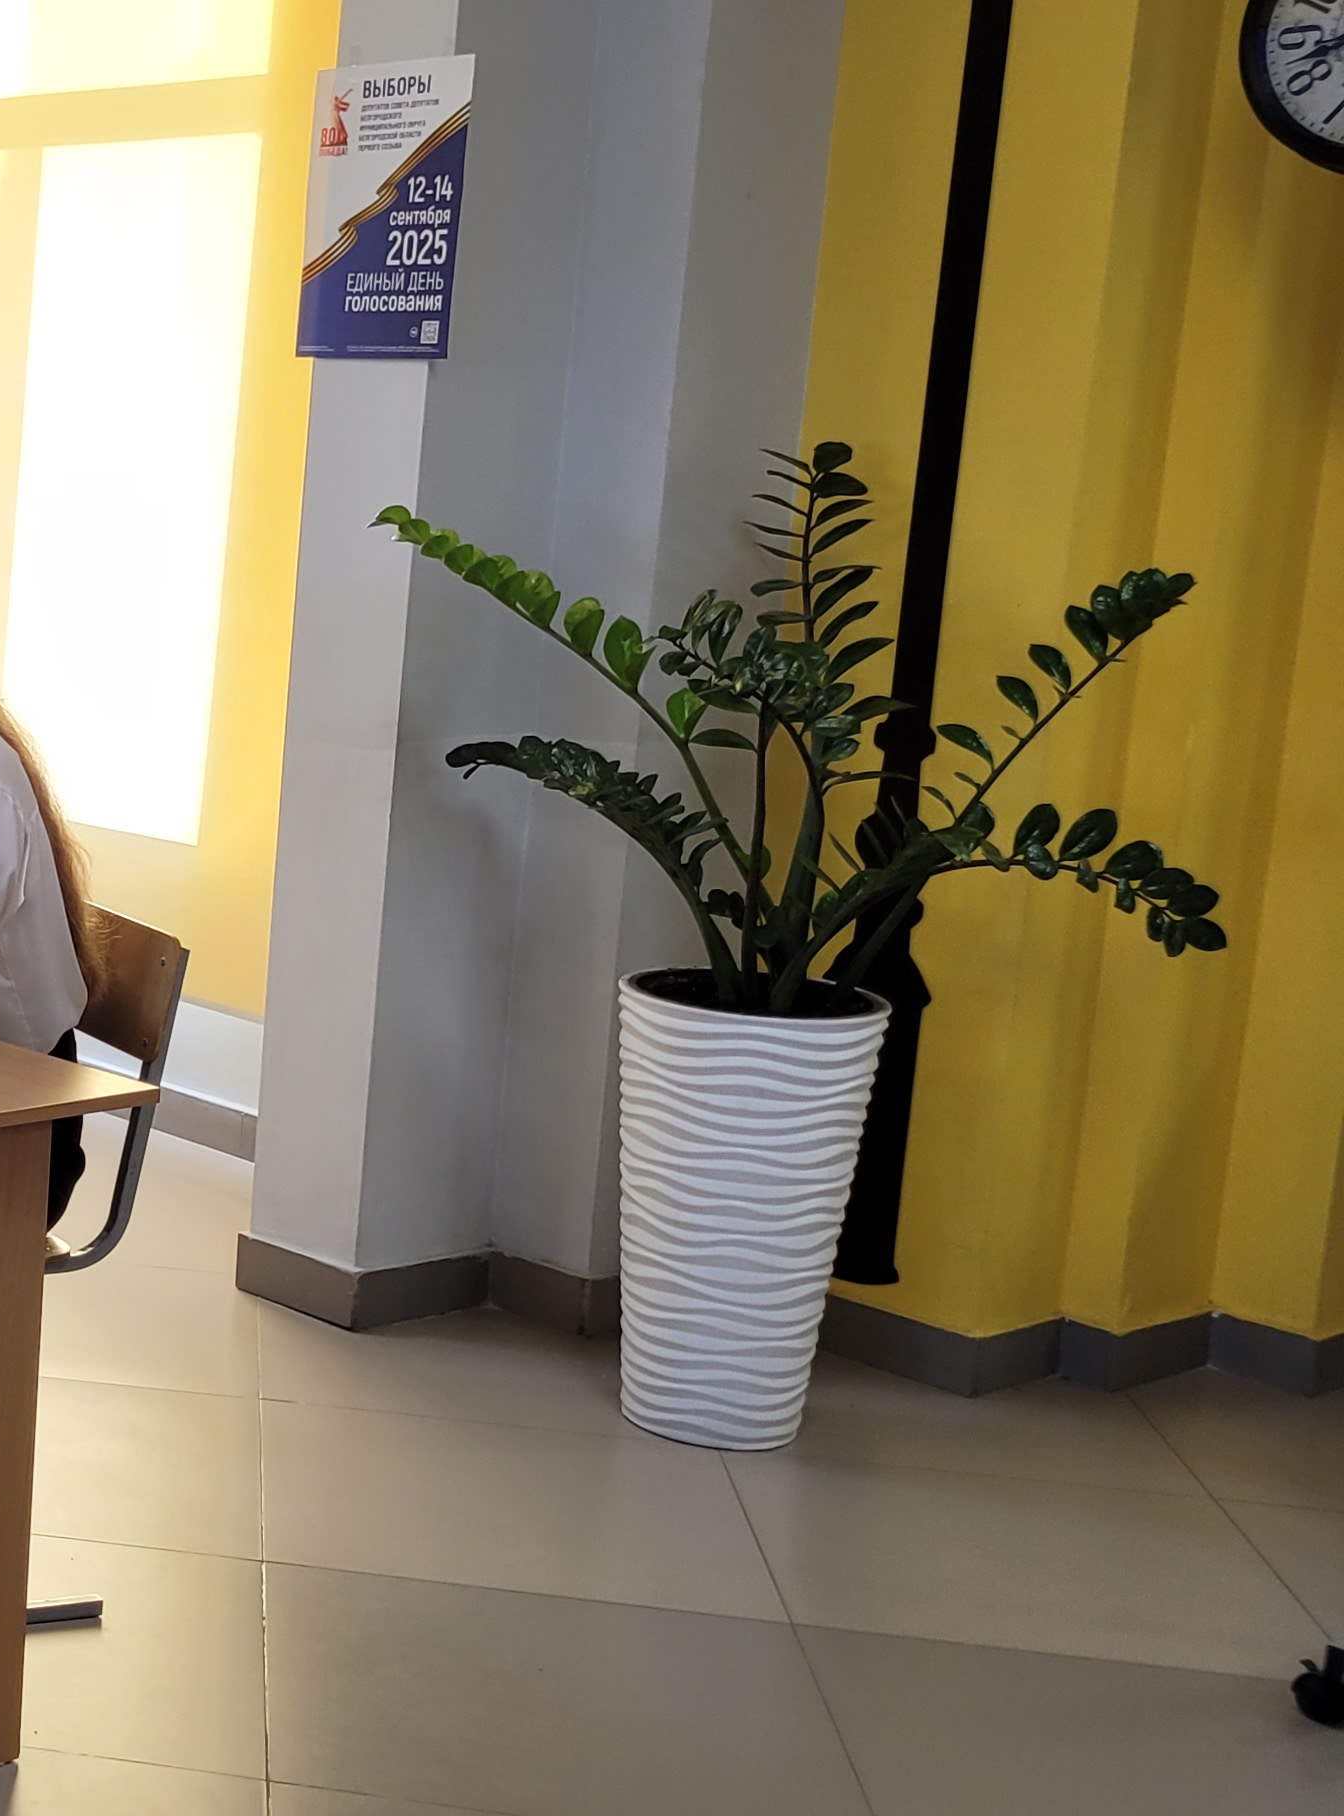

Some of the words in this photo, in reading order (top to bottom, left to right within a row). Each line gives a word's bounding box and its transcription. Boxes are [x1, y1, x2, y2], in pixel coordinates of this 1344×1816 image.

[363, 74, 432, 99] ВЫБОРЫ
[1287, 59, 1332, 96] 8
[407, 174, 453, 203] 12-14
[389, 205, 451, 228] сентября
[386, 229, 449, 266] 2025
[346, 268, 405, 293] ЕДИНЫЙ
[407, 271, 444, 293] ДЕНЬ
[345, 295, 443, 312] голосования
